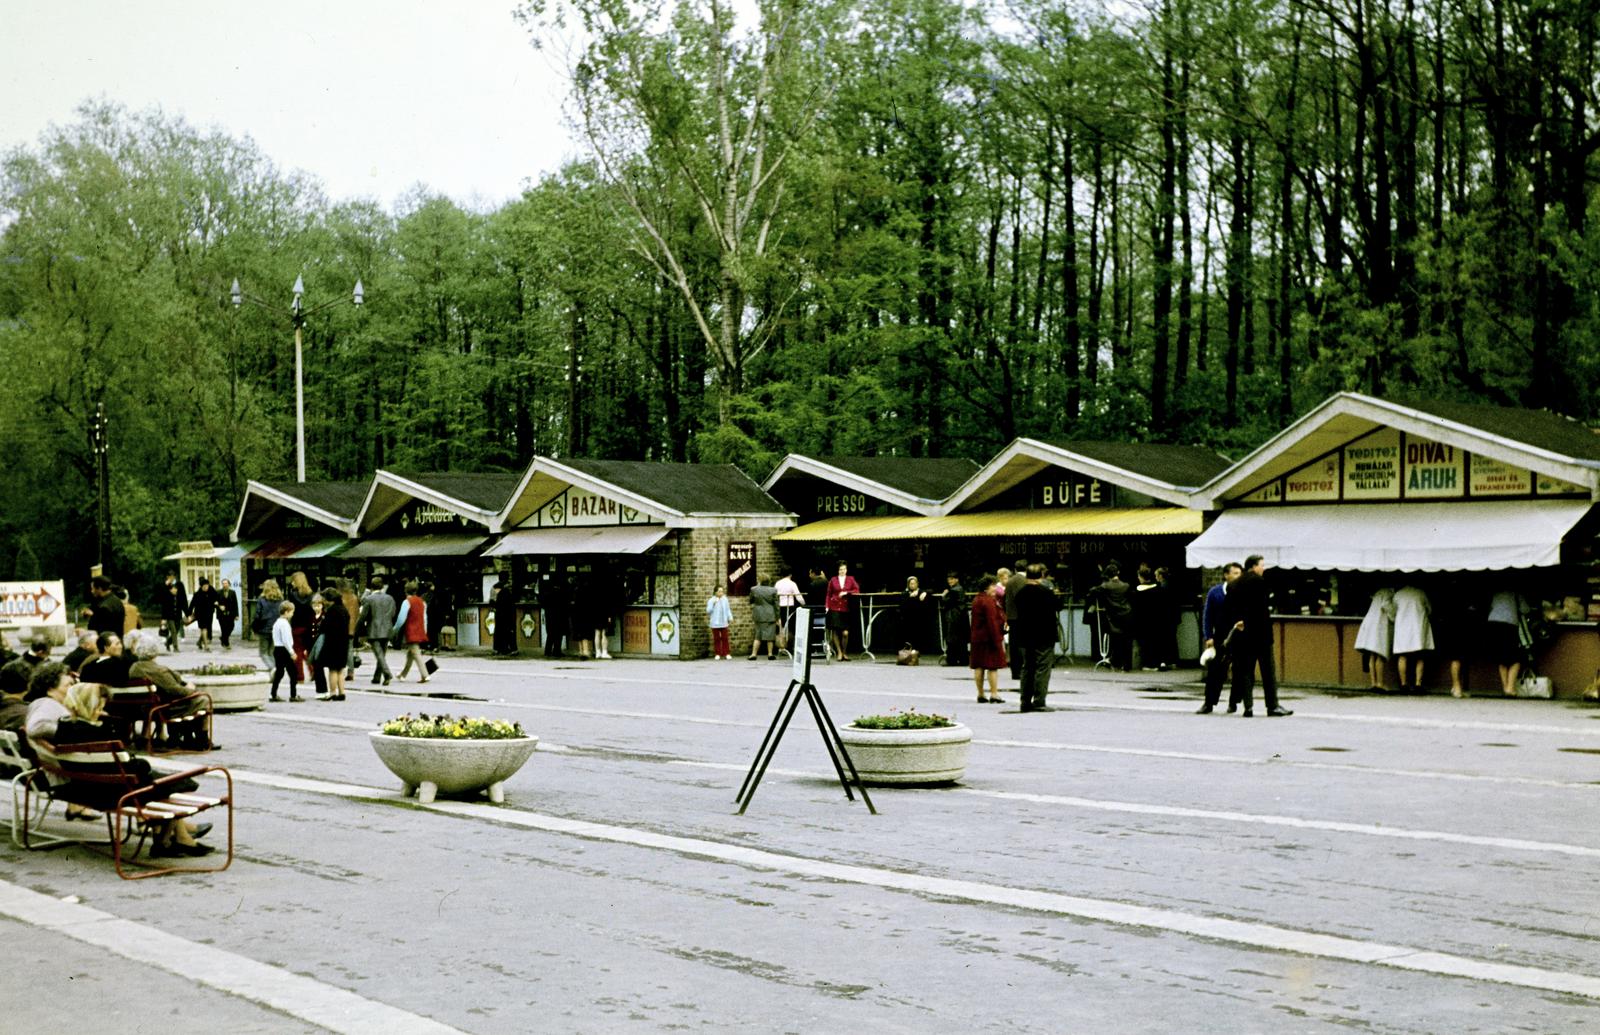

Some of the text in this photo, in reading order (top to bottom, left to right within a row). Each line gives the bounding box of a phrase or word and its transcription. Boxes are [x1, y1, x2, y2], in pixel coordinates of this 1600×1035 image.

[1407, 442, 1454, 464] DIVAT
[1408, 465, 1457, 490] ÁRUK
[817, 494, 866, 513] PRESSO
[1043, 479, 1101, 505] BÜFÉ
